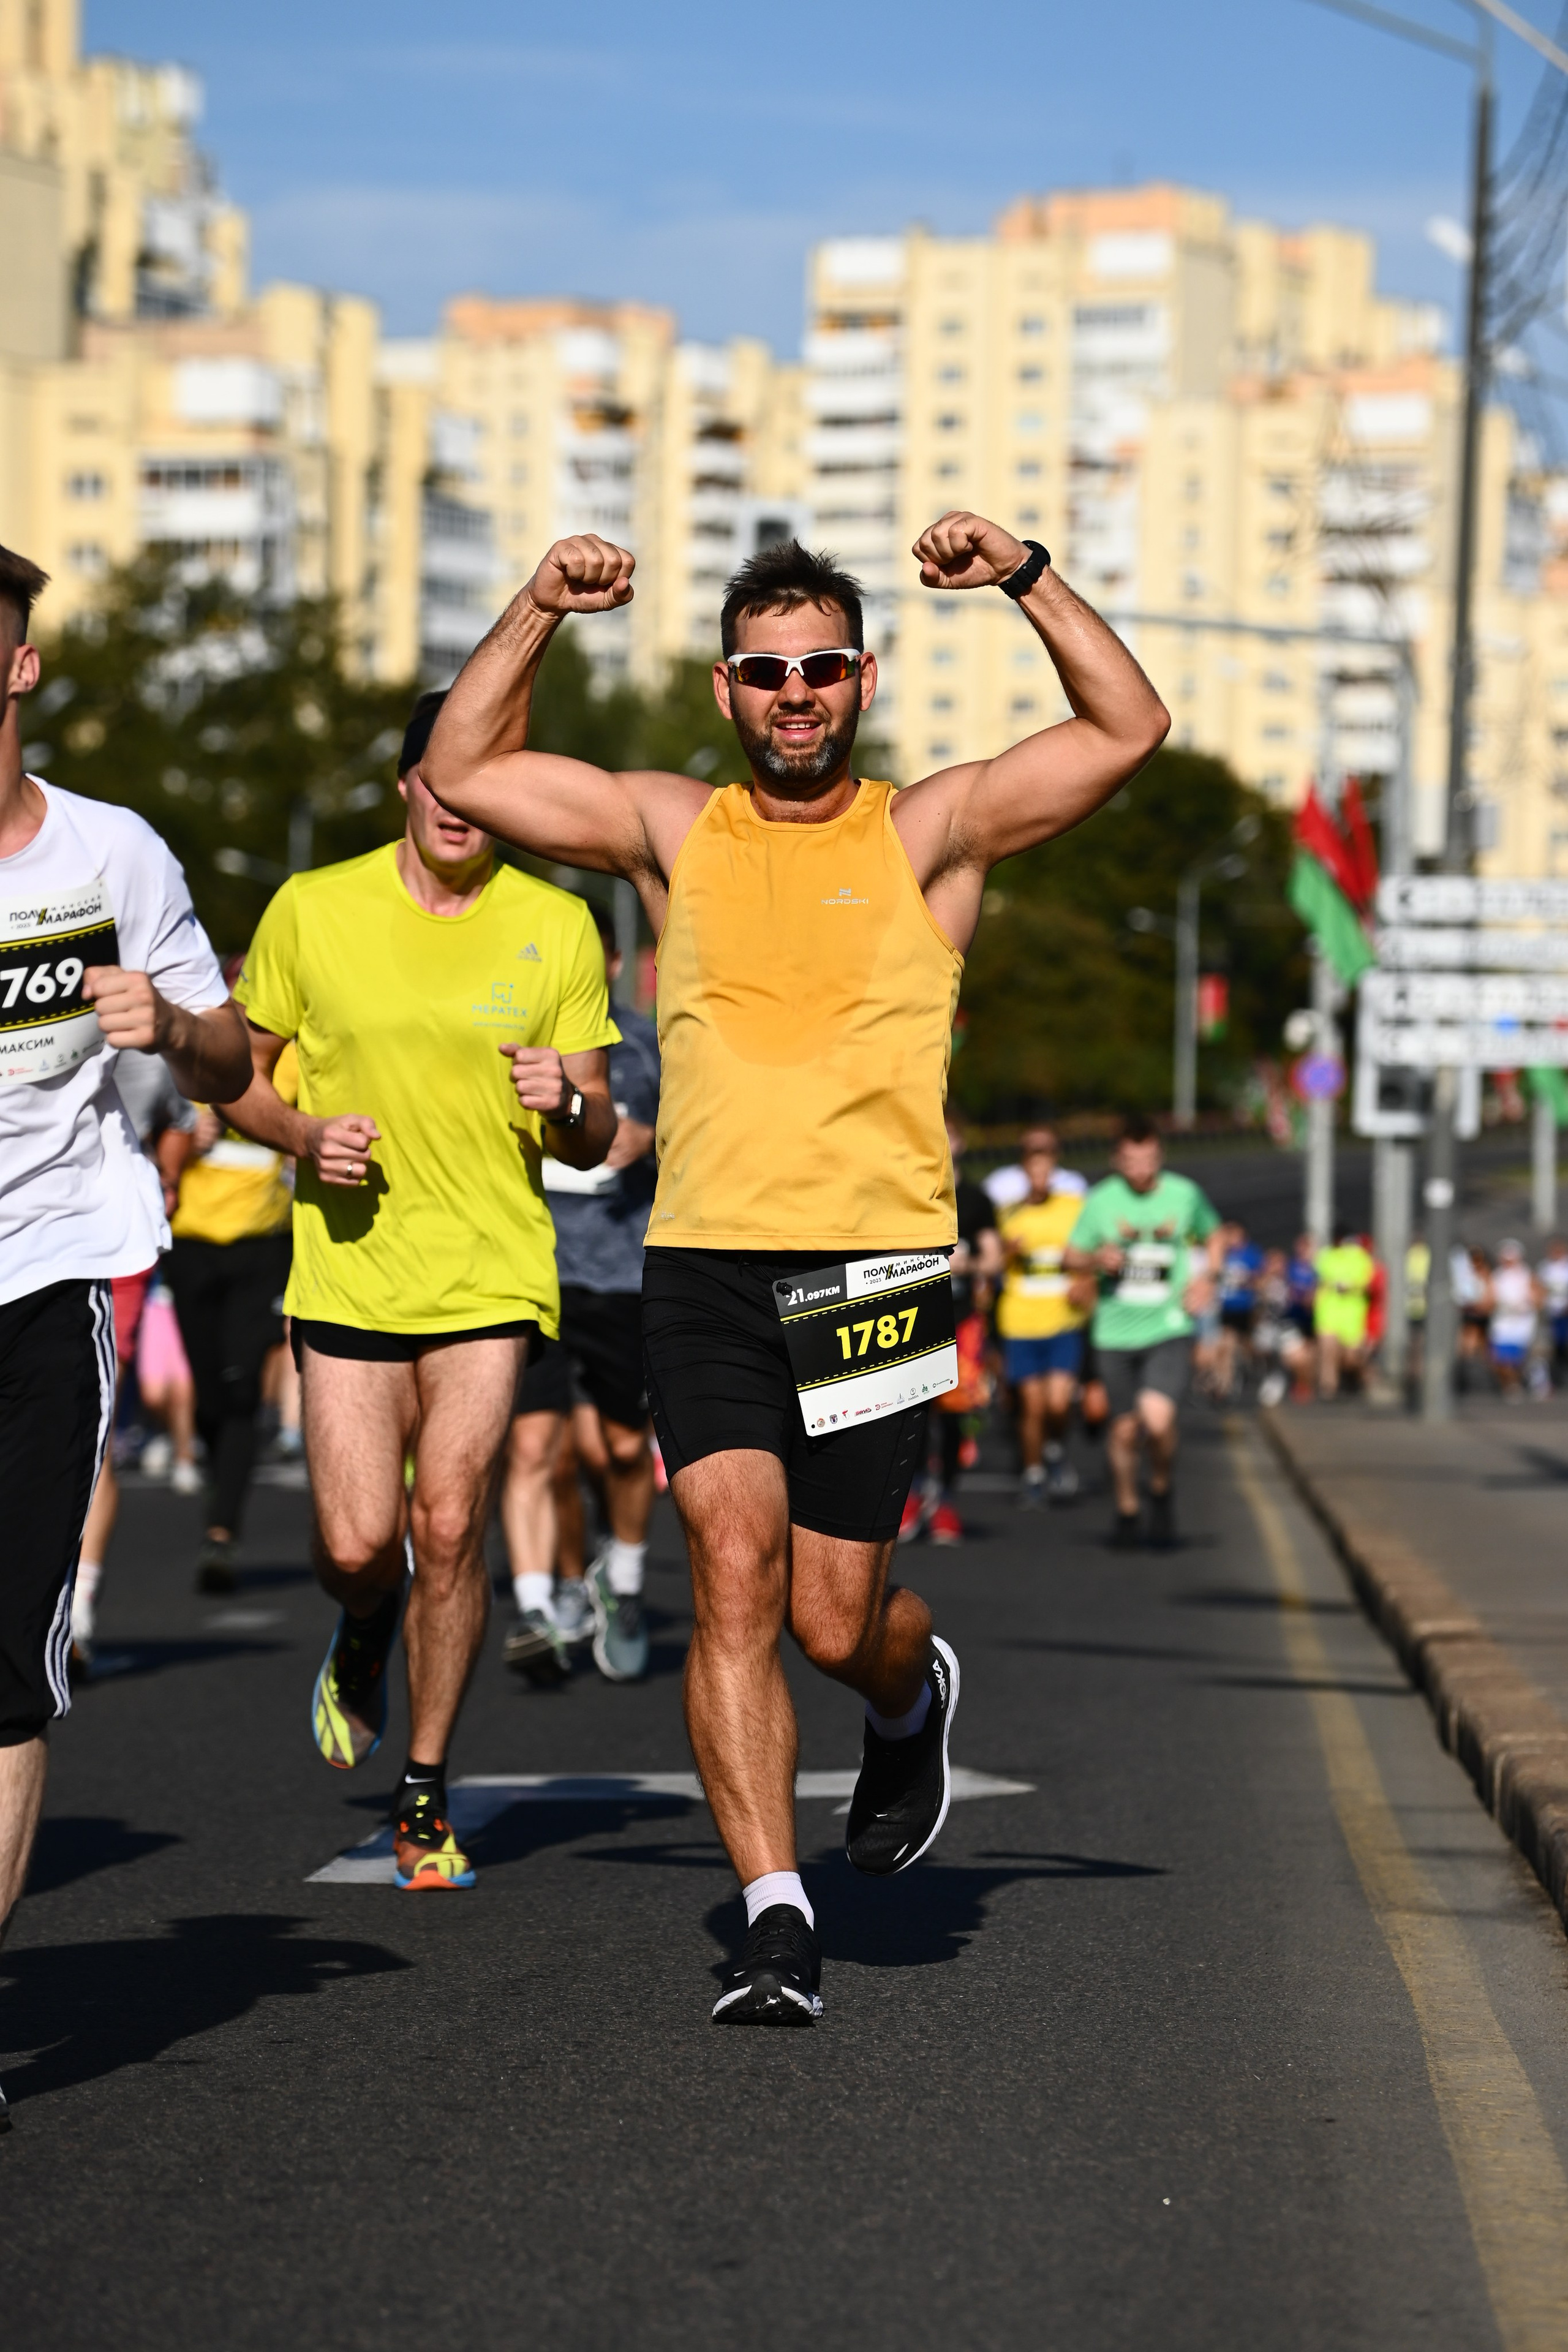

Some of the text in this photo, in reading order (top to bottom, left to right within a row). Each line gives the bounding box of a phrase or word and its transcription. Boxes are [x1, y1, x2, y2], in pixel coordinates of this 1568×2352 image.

[0, 957, 84, 1009] 769
[0, 1035, 55, 1055] МАКСИМ
[836, 1306, 919, 1360] 1787
[932, 1659, 946, 1709] HOKA
